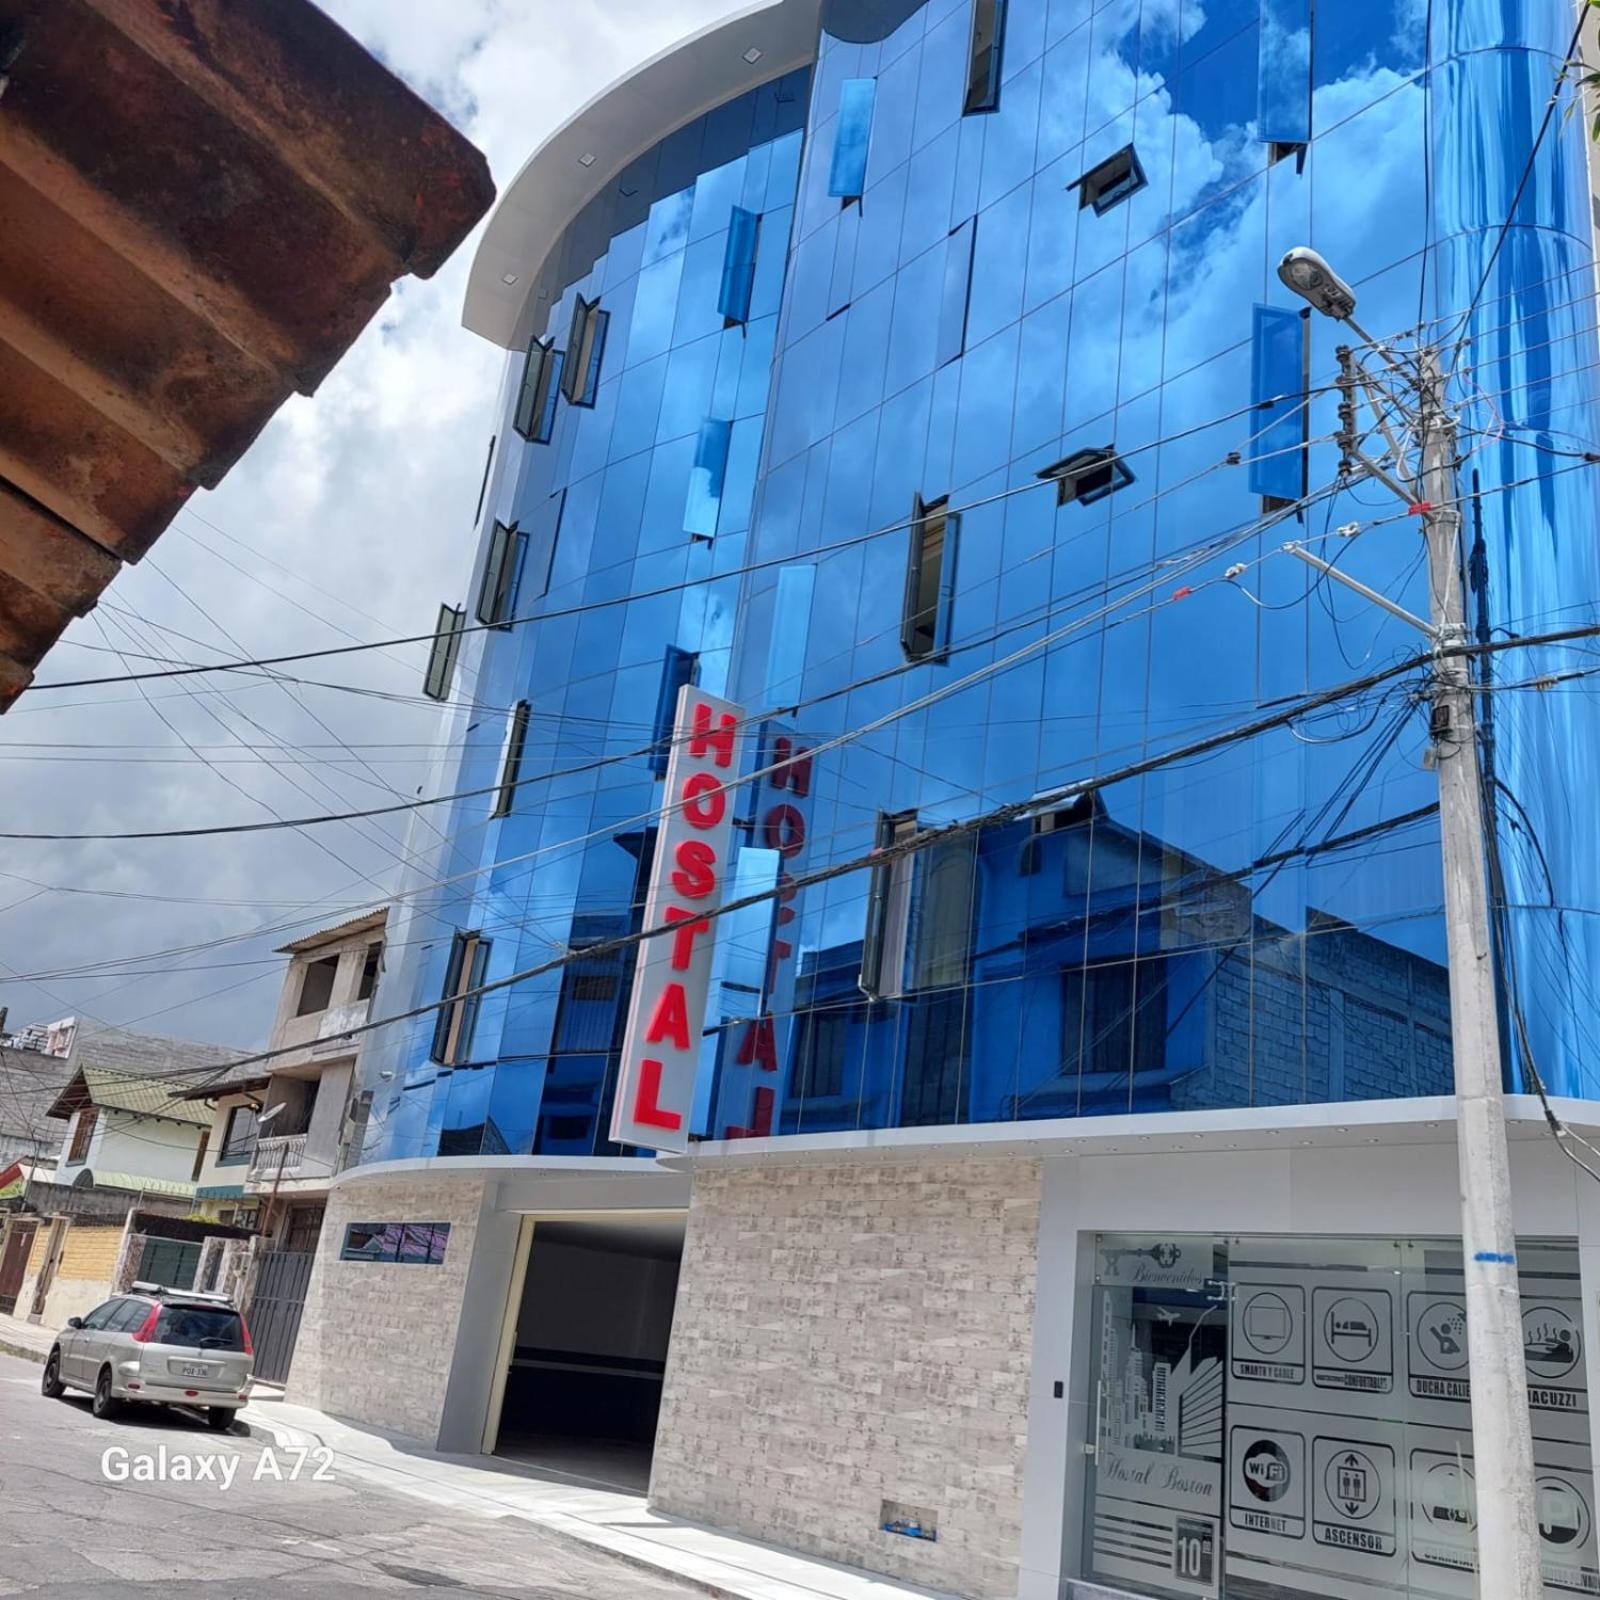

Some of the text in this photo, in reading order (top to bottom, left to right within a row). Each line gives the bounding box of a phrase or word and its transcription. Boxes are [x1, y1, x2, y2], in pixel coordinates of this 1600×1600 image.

[633, 702, 738, 1131] HOSTAL
[1416, 1380, 1445, 1395] DUCHA
[1106, 1452, 1213, 1496] Hostal Boston
[1244, 1512, 1287, 1532] INTERNET
[1324, 1527, 1383, 1550] ASCENSOR
